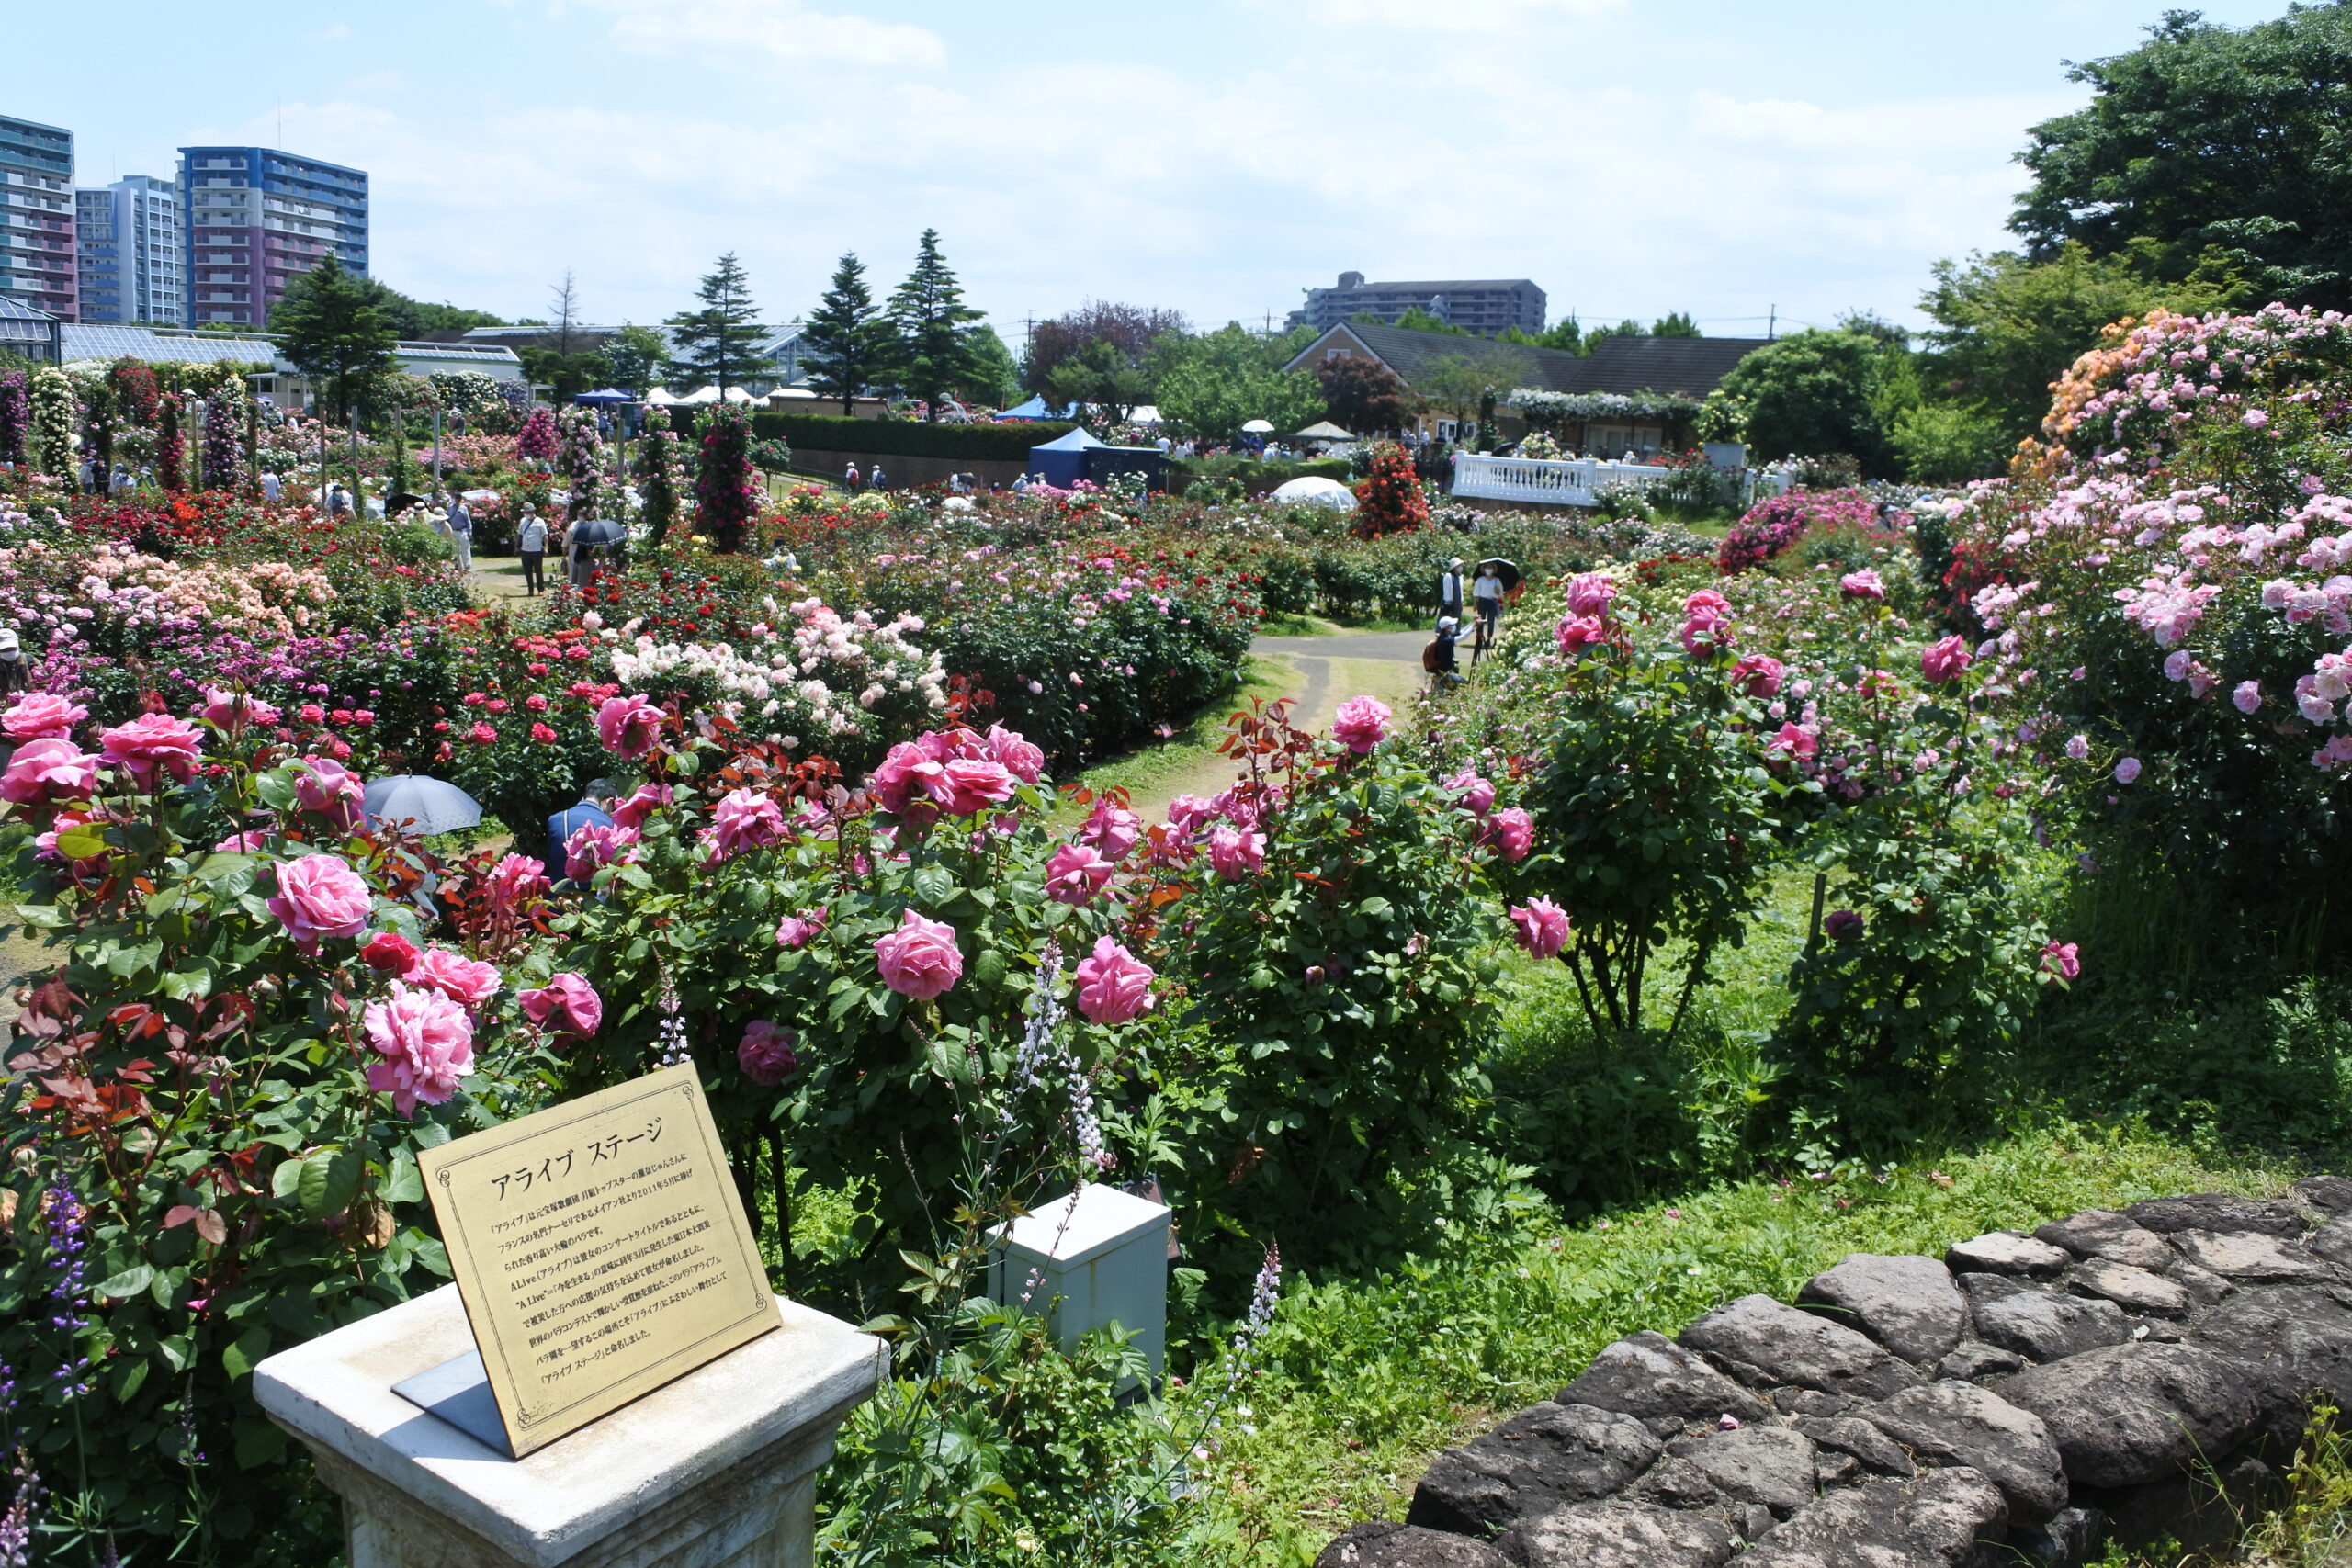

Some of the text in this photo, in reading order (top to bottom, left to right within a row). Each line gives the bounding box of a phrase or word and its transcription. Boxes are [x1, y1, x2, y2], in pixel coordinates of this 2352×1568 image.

[491, 1116, 662, 1202] アライブ ステージ
[504, 1225, 604, 1272] られた香り高い大輪のバラです。
[522, 1244, 705, 1329] で被災した方への応援の気持ちを込めて彼女が命名しました。
